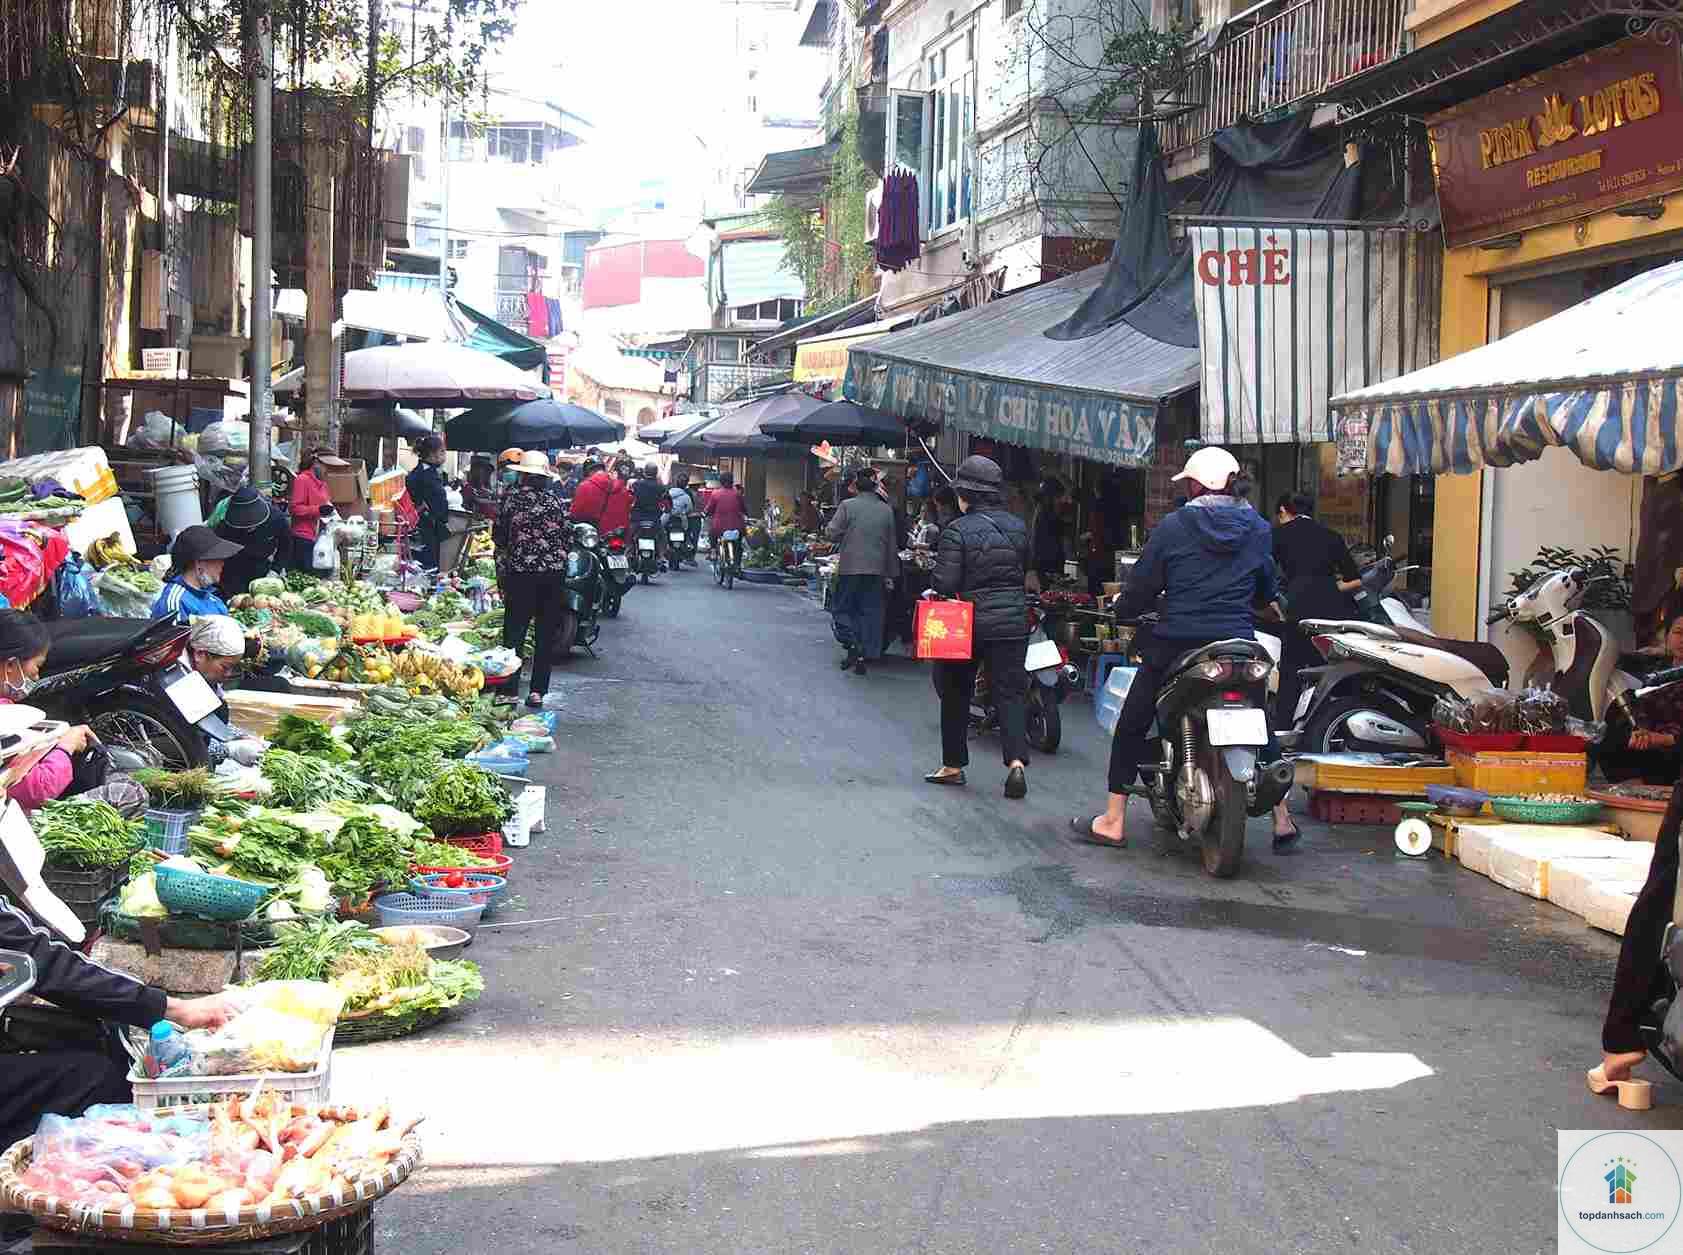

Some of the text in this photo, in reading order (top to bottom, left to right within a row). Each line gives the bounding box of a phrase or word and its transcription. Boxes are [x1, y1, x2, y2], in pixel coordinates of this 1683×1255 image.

[1479, 72, 1661, 169] PINK LOTUS
[1198, 236, 1290, 286] CHÈ
[1046, 402, 1090, 443] HOA
[1098, 402, 1155, 459] VÂN
